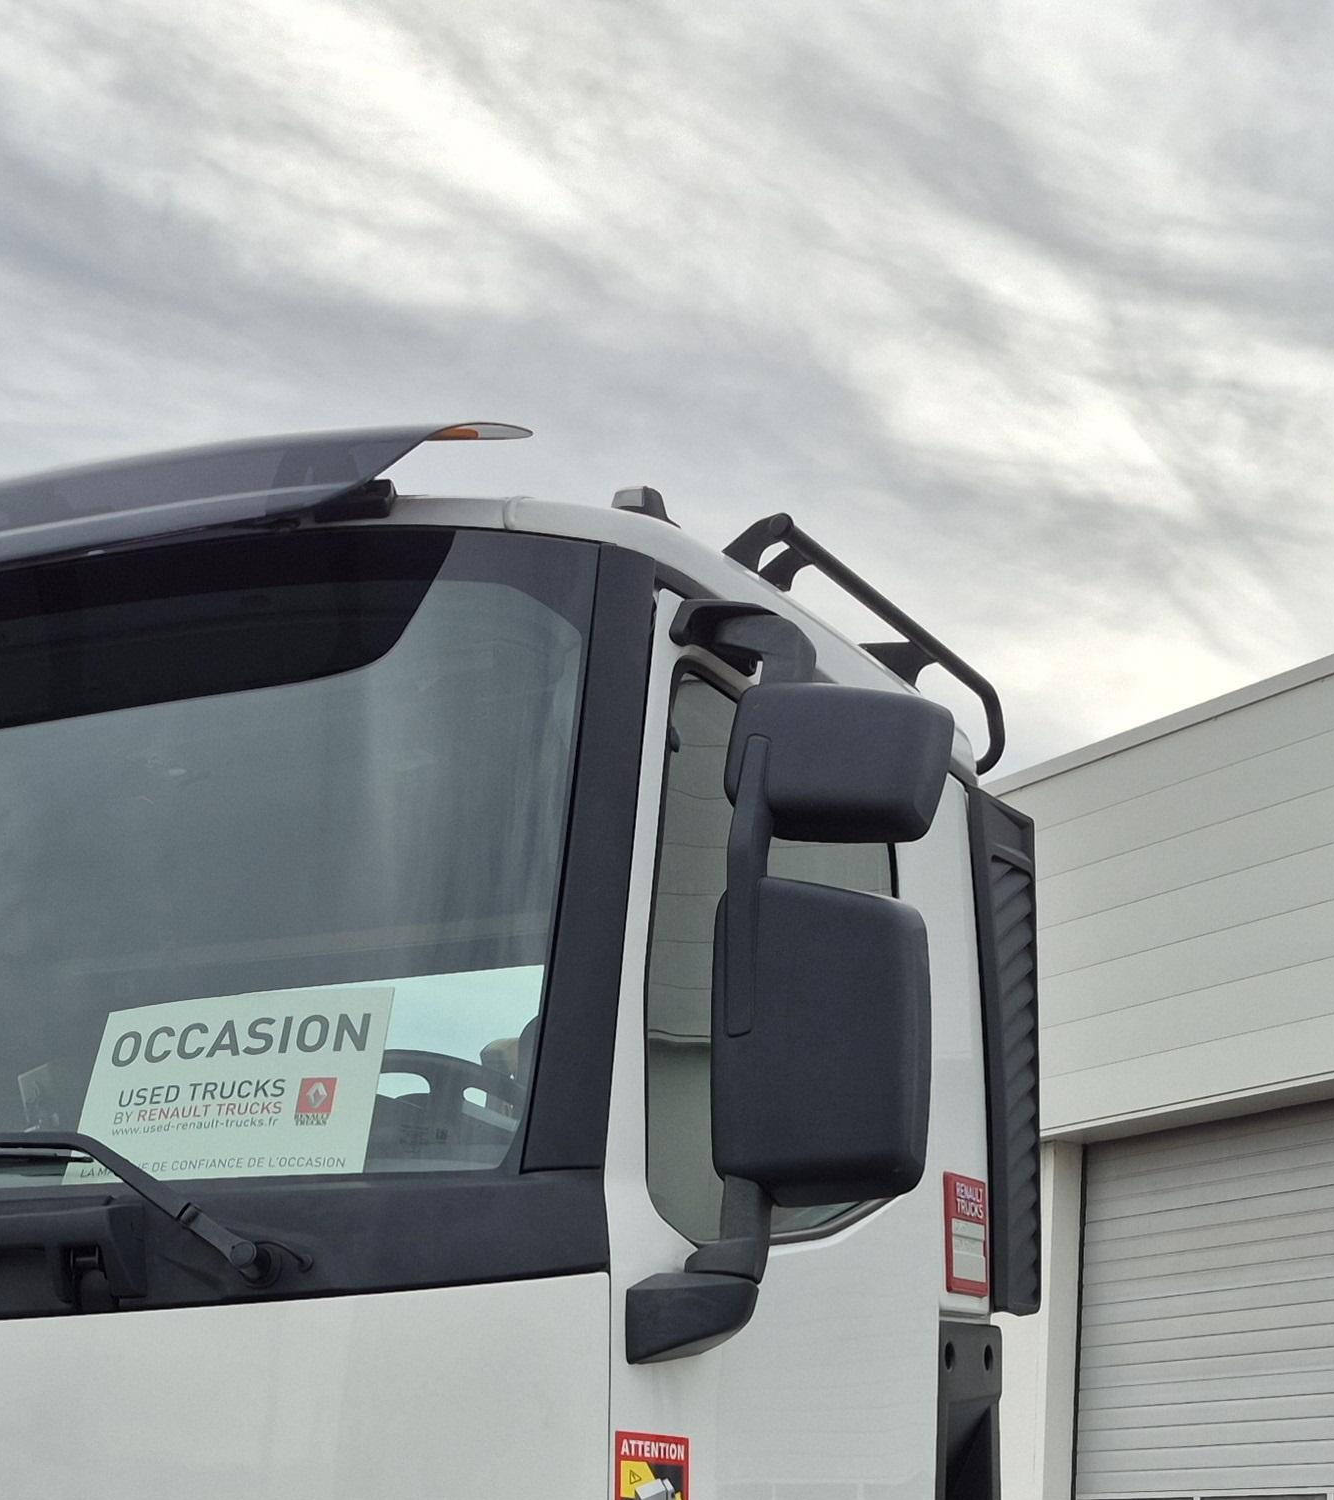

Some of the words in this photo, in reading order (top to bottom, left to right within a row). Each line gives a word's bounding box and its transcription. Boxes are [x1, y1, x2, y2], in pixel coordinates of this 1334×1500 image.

[111, 1013, 371, 1068] OCCASION
[118, 1084, 180, 1108] USED
[189, 1078, 287, 1102] TRUCKS
[113, 1111, 134, 1126] BY
[137, 1104, 211, 1123] RENAULT
[216, 1101, 283, 1117] TRUCKS
[111, 1116, 279, 1137] www.used-renault-trucks.fr
[152, 1161, 168, 1173] DE
[171, 1158, 243, 1171] CONFIANCE
[247, 1157, 264, 1169] DE
[268, 1156, 346, 1168] L'OCCASION
[956, 1198, 984, 1219] TRUCKS
[621, 1438, 685, 1461] ATTENTION
